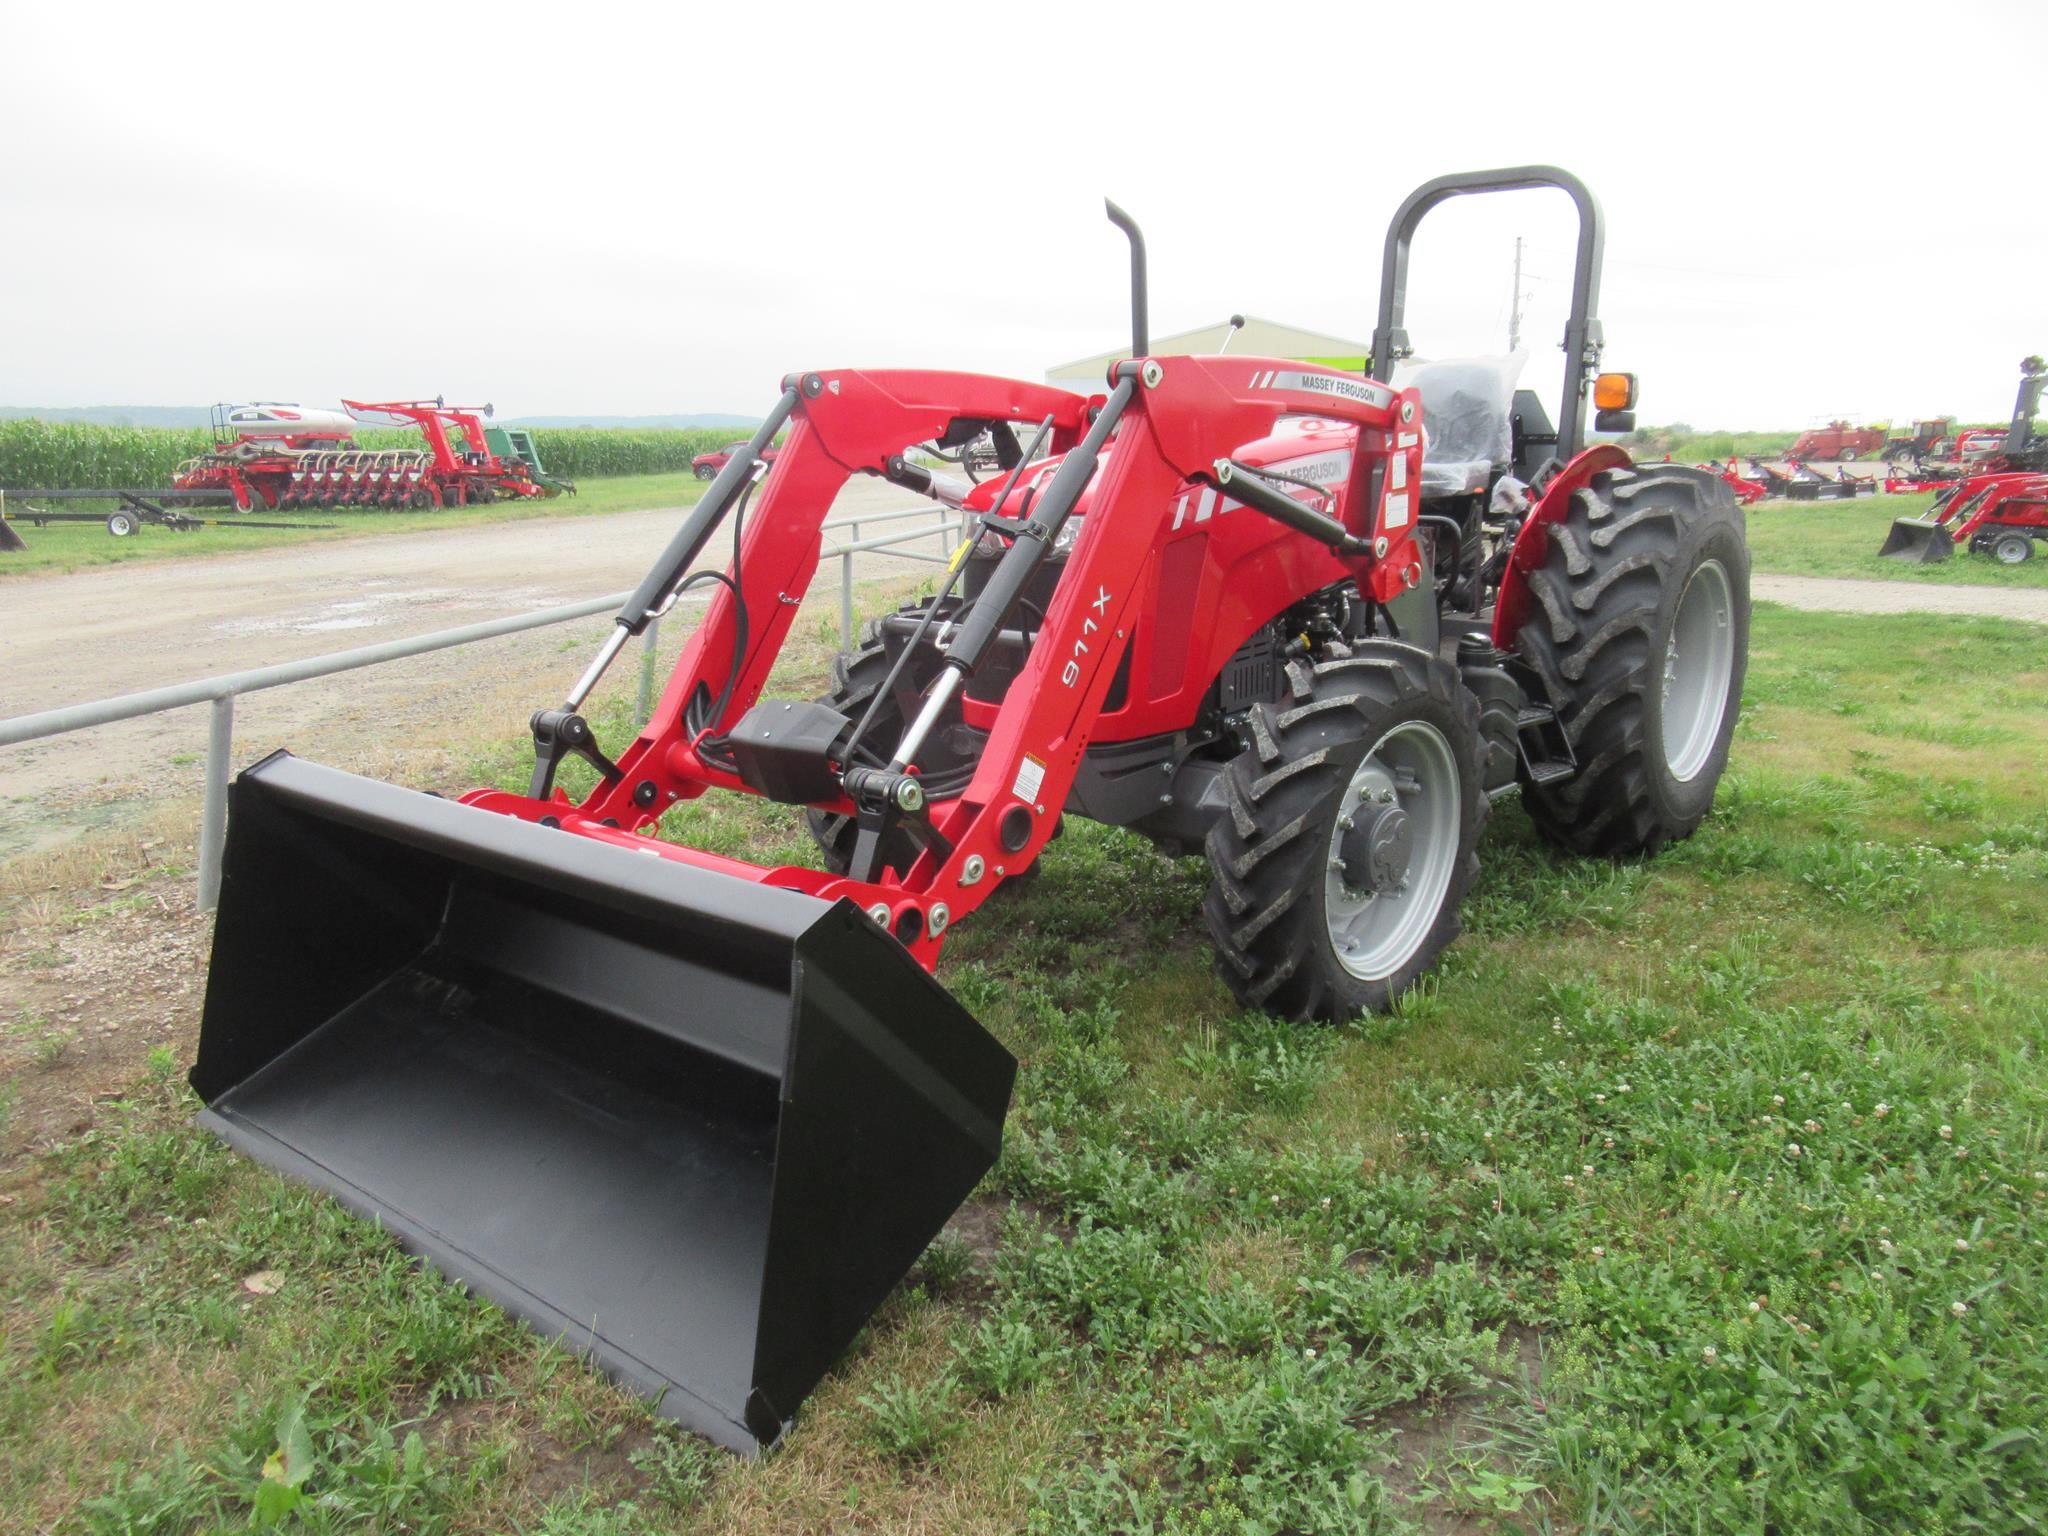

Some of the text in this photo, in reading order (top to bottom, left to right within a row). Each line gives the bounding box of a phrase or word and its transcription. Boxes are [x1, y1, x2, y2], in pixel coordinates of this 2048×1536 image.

[1302, 375, 1376, 402] MASSEY FERGUSON
[1290, 460, 1342, 481] FERGUSON
[1061, 584, 1112, 688] 911X
